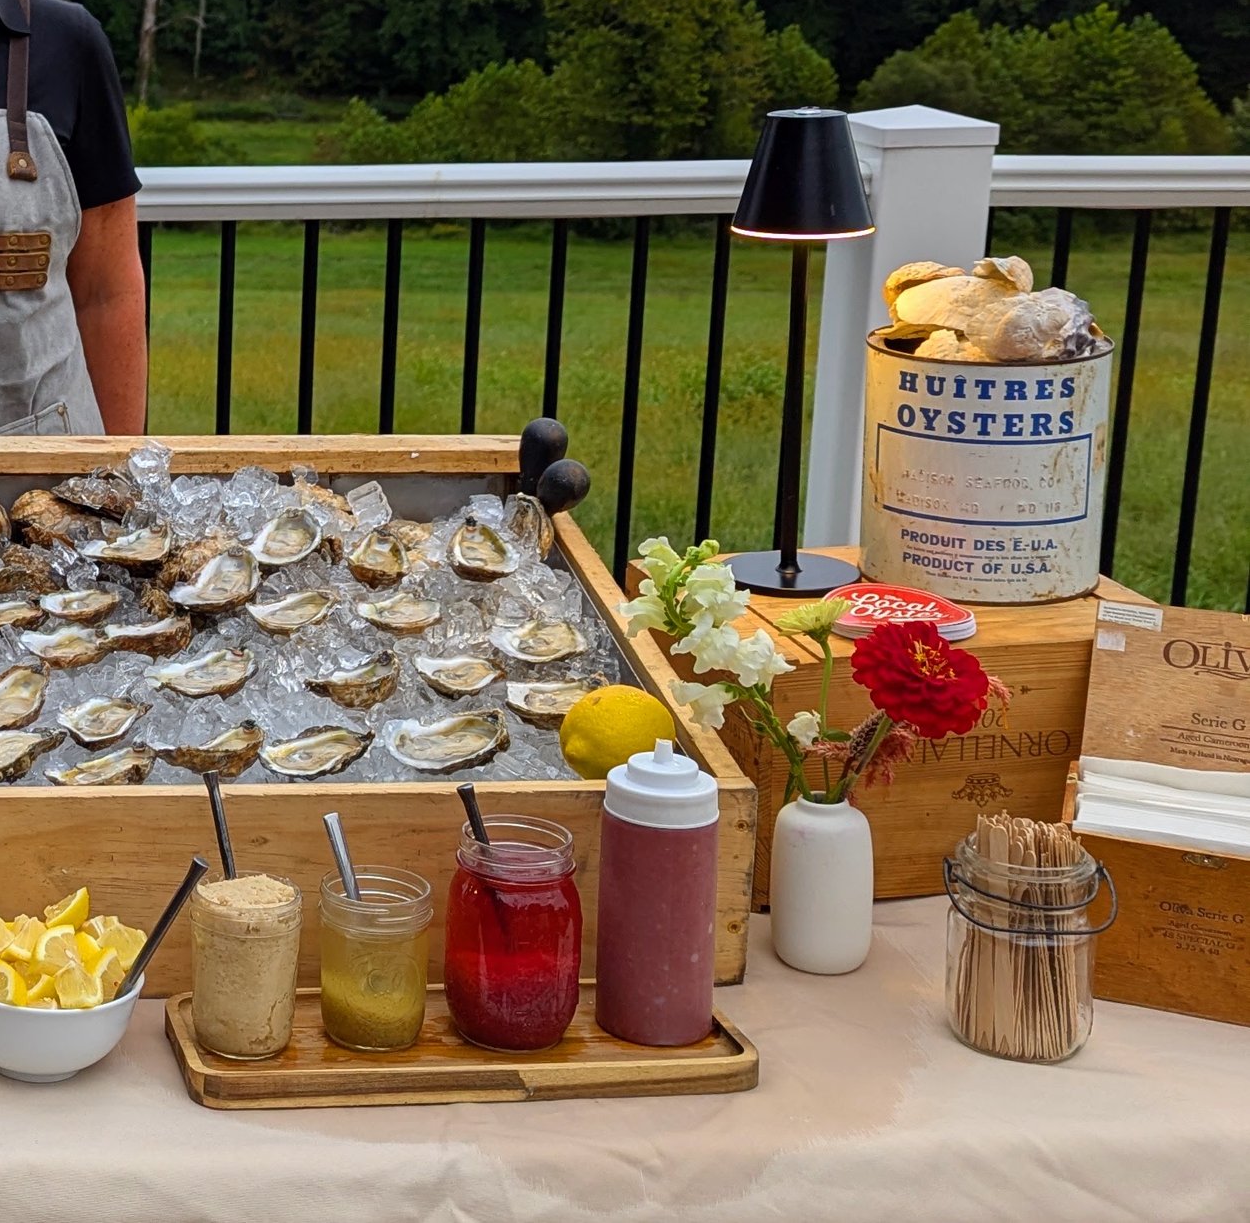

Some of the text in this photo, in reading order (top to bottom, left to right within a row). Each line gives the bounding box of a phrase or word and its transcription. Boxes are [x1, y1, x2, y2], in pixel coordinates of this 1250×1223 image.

[899, 370, 1076, 401] HUÎTRES
[897, 403, 1075, 437] OYSTERS
[901, 528, 967, 550] PRODUIT
[974, 539, 1005, 552] DES
[902, 551, 975, 574] PRODUCT
[981, 563, 1004, 575] OF
[1011, 561, 1052, 575] U.S.A.
[848, 592, 939, 612] Local
[850, 604, 950, 619] Oyster
[1191, 712, 1247, 731] Serie G
[914, 729, 1071, 764] ORNELLAI
[1177, 731, 1250, 750] Aged Cameroon
[1196, 906, 1228, 922] Serie
[1232, 913, 1245, 924] G
